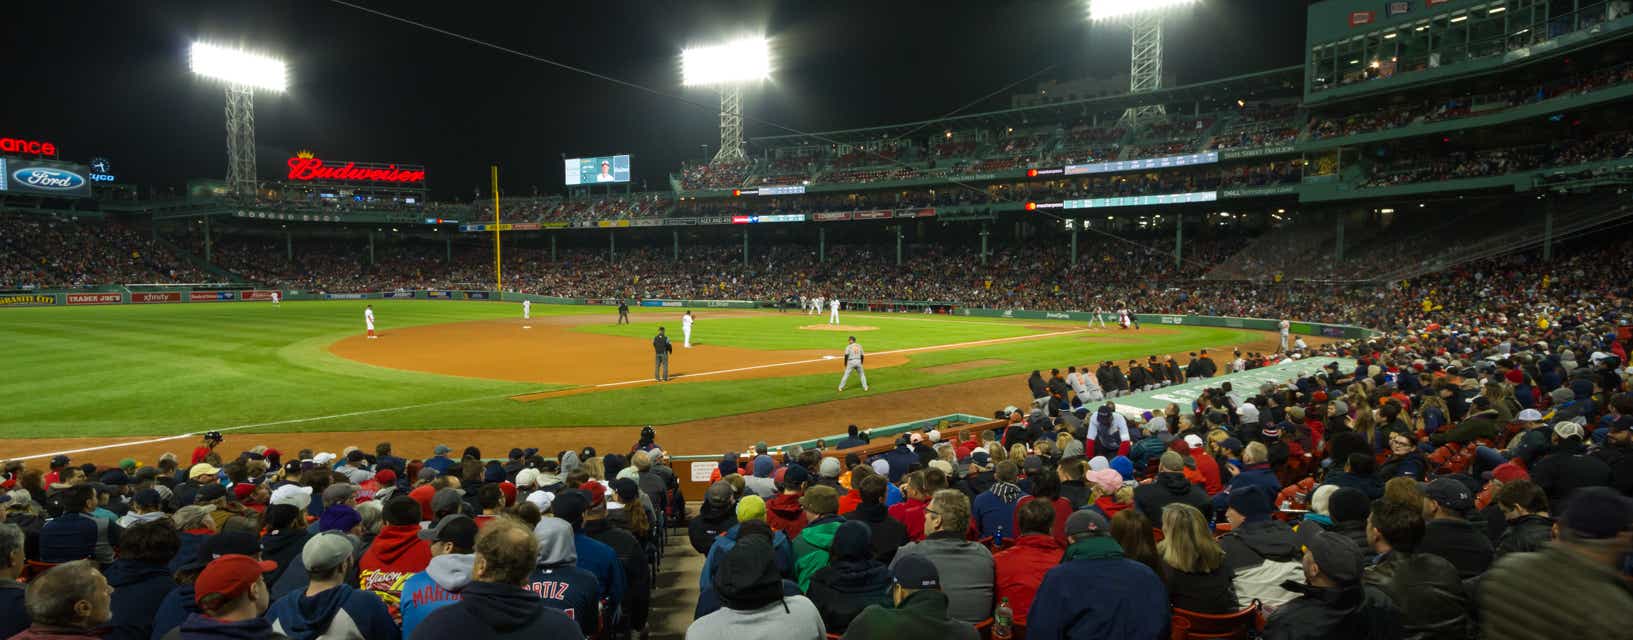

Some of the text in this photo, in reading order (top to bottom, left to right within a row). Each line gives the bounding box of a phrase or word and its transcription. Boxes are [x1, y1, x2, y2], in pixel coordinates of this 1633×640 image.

[288, 157, 424, 182] Budweiser
[28, 170, 71, 187] Ford
[89, 173, 115, 182] yco
[144, 293, 168, 303] xfinity
